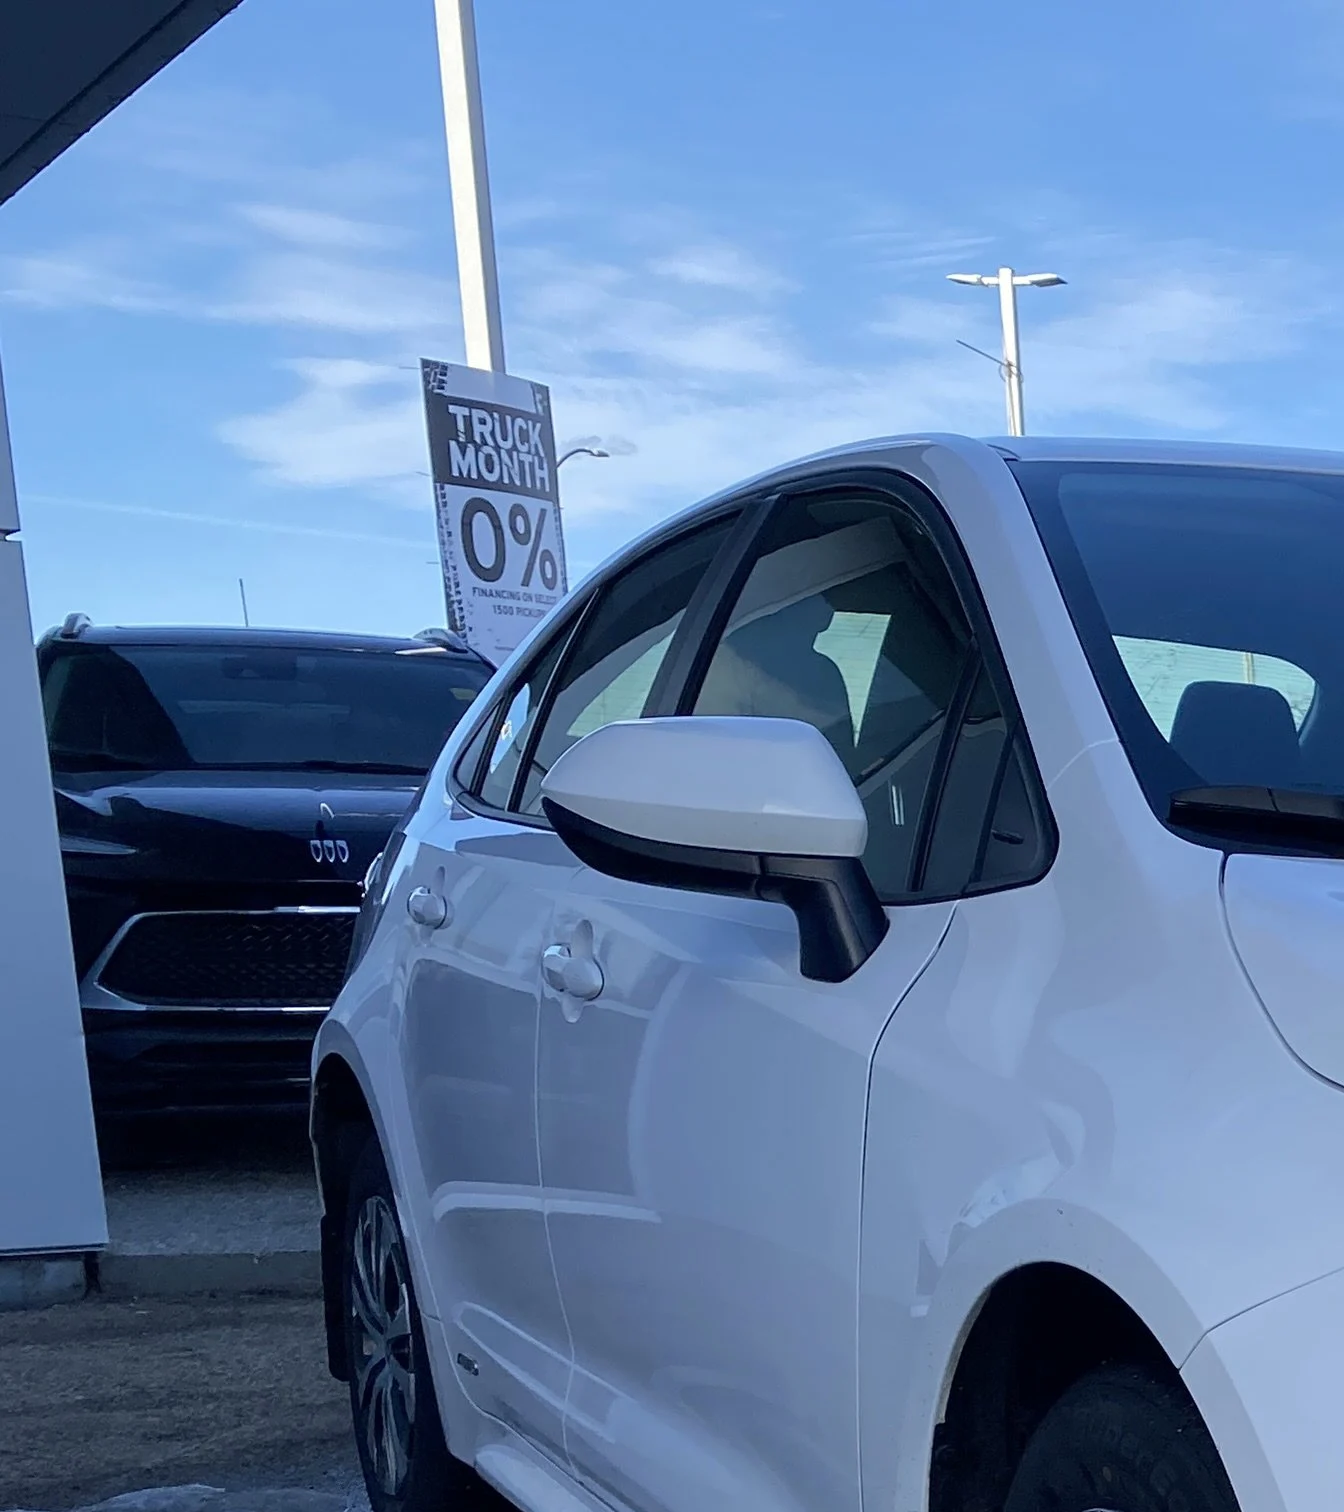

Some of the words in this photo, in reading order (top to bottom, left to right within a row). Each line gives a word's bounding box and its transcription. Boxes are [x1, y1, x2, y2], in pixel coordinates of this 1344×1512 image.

[447, 404, 544, 458] TRUCK
[448, 440, 550, 493] MONTH
[461, 497, 558, 591] 0%
[472, 587, 520, 601] FINANCING
